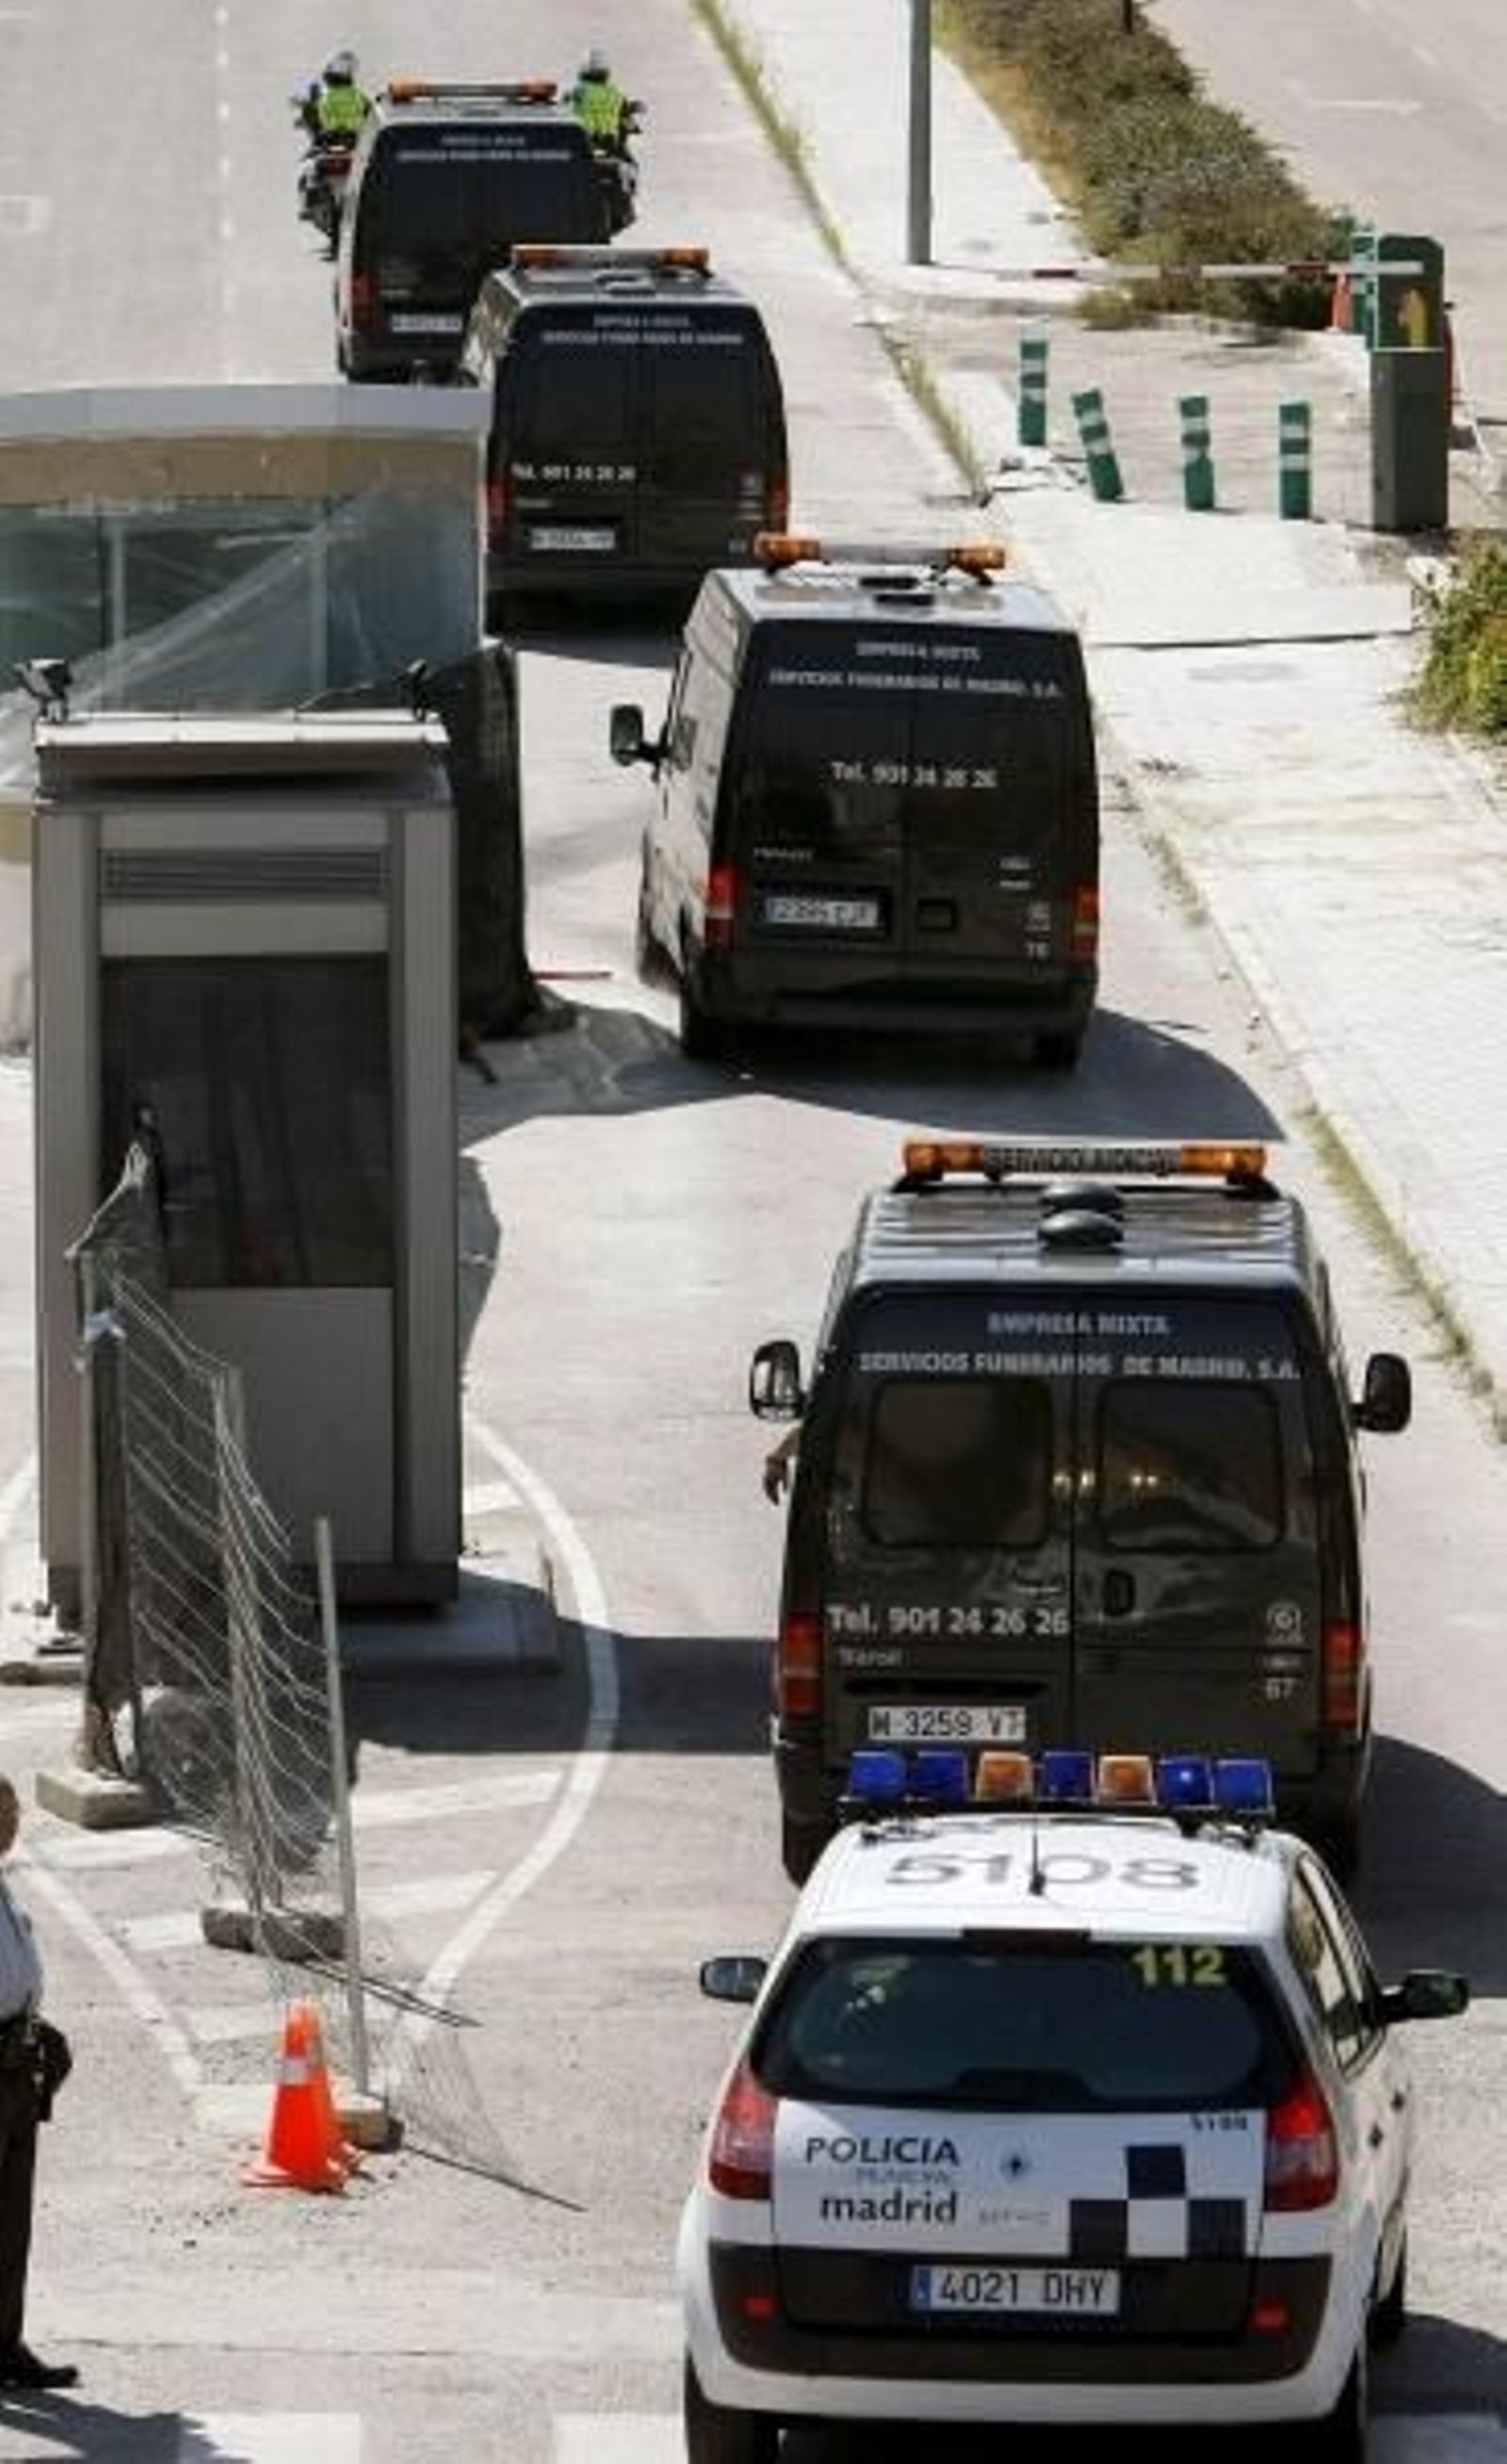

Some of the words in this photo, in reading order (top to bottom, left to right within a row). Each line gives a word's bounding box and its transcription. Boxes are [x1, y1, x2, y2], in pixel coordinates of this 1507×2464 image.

[859, 1353, 969, 1372] SERVICIOS
[888, 1605, 940, 1634] 901
[948, 1607, 984, 1635] 24
[989, 1607, 1027, 1635] 26
[1034, 1608, 1071, 1635] 26
[885, 1854, 1199, 1890] 5108
[1134, 1945, 1224, 1987] 112
[805, 2136, 961, 2166] POLICIA
[821, 2190, 959, 2224] madrid
[942, 2268, 1020, 2305] 4021
[1043, 2272, 1106, 2306] DHY
